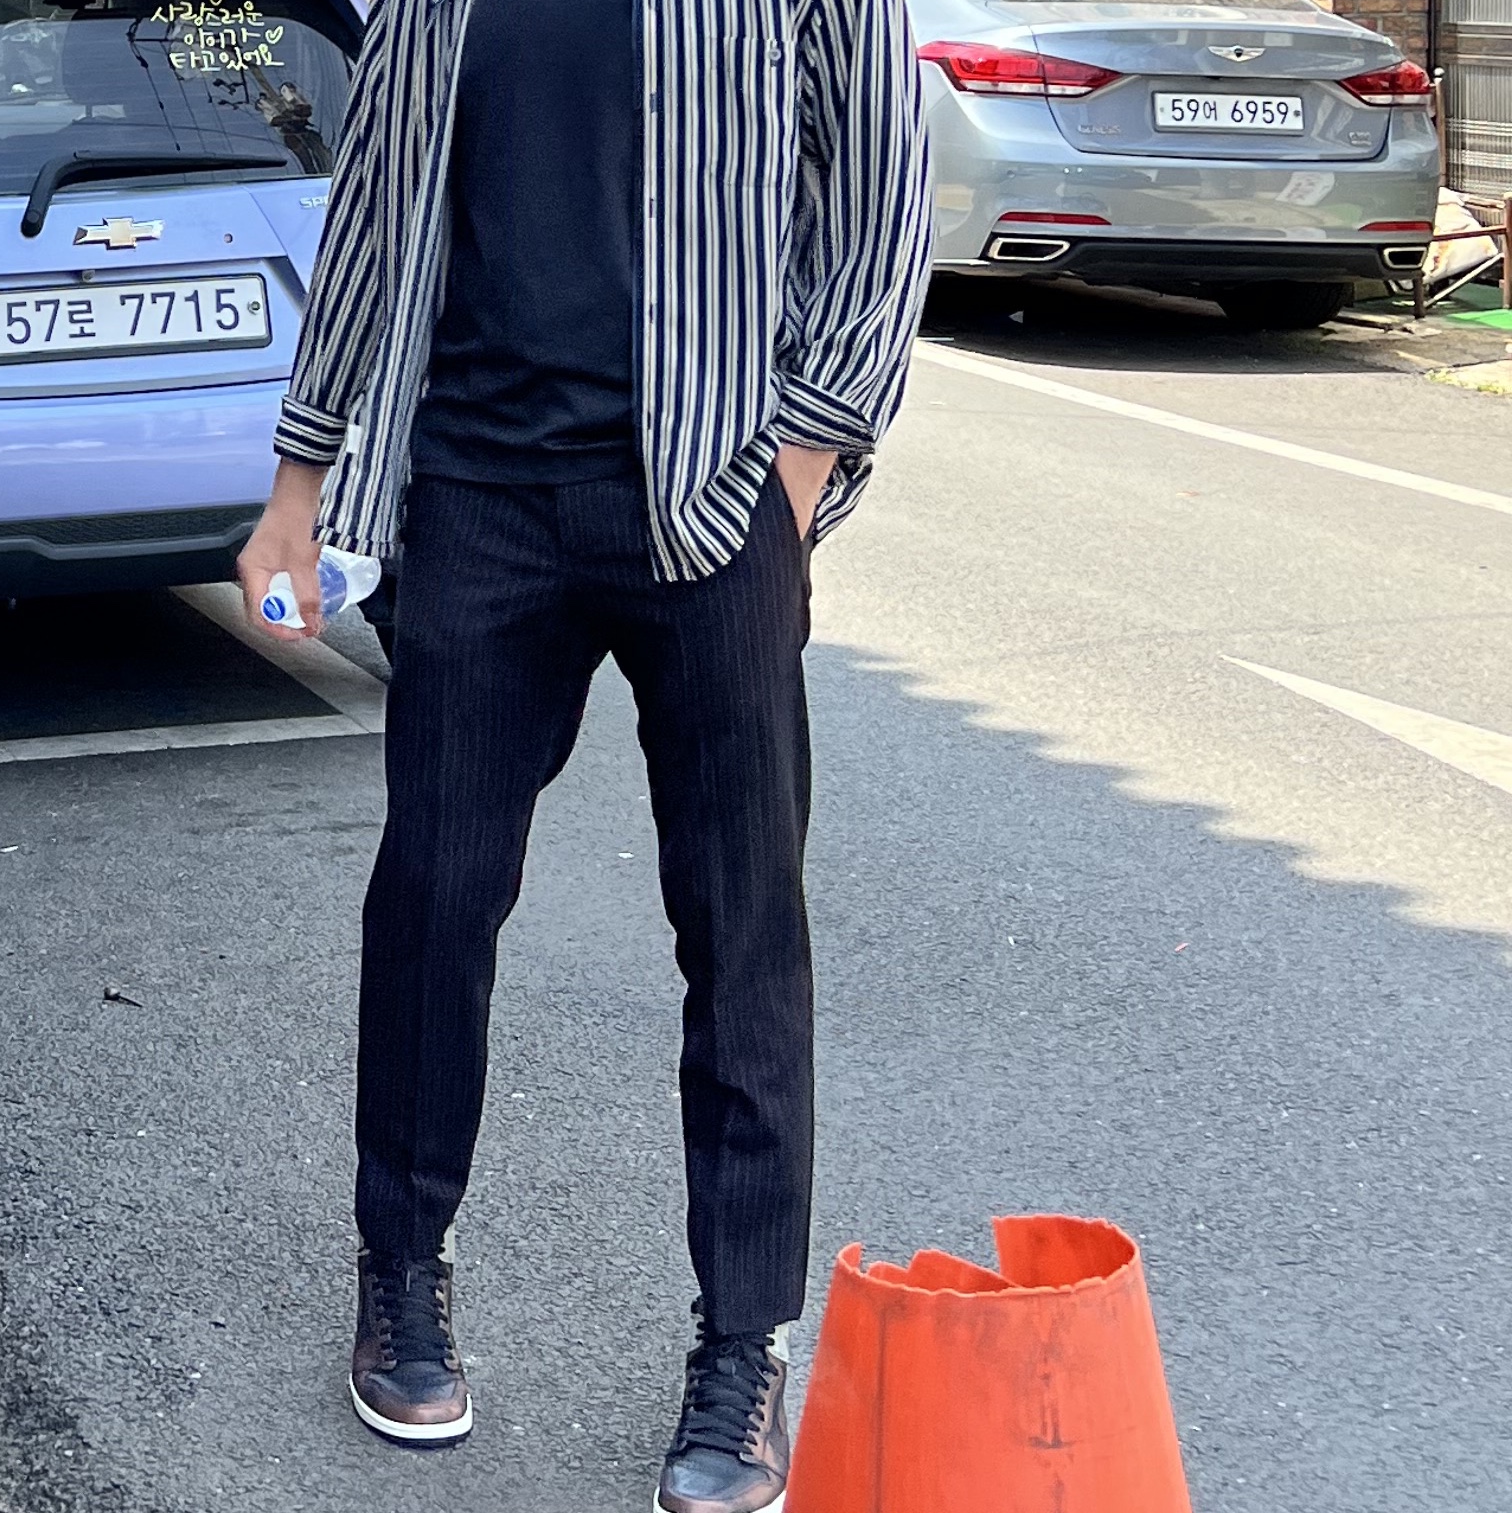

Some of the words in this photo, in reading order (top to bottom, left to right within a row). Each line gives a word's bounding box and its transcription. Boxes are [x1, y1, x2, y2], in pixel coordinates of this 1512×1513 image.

[150, 0, 265, 26] 사랑스러운
[184, 28, 261, 49] 아이가
[1171, 98, 1218, 122] 59어
[1230, 100, 1290, 125] 6959
[6, 298, 96, 345] 57로
[119, 287, 240, 337] 7715
